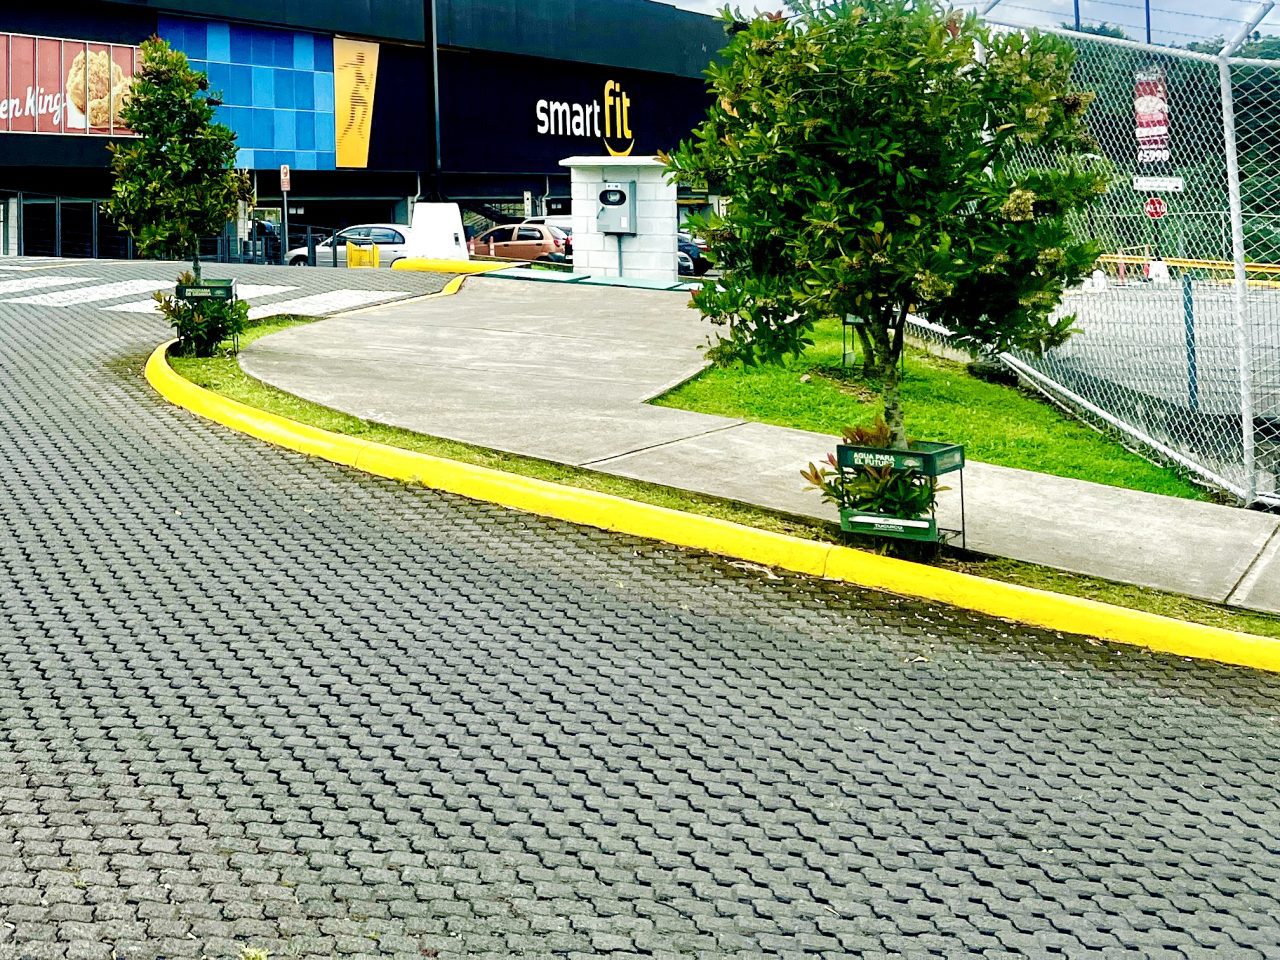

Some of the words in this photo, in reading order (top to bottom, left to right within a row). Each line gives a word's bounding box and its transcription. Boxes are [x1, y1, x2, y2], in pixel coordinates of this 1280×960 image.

[25, 86, 66, 125] King
[536, 99, 601, 138] smart
[604, 79, 632, 139] fit
[1146, 203, 1166, 213] ALTO
[853, 452, 875, 460] AGUA
[875, 453, 895, 461] PARA
[865, 459, 895, 468] FUTURO
